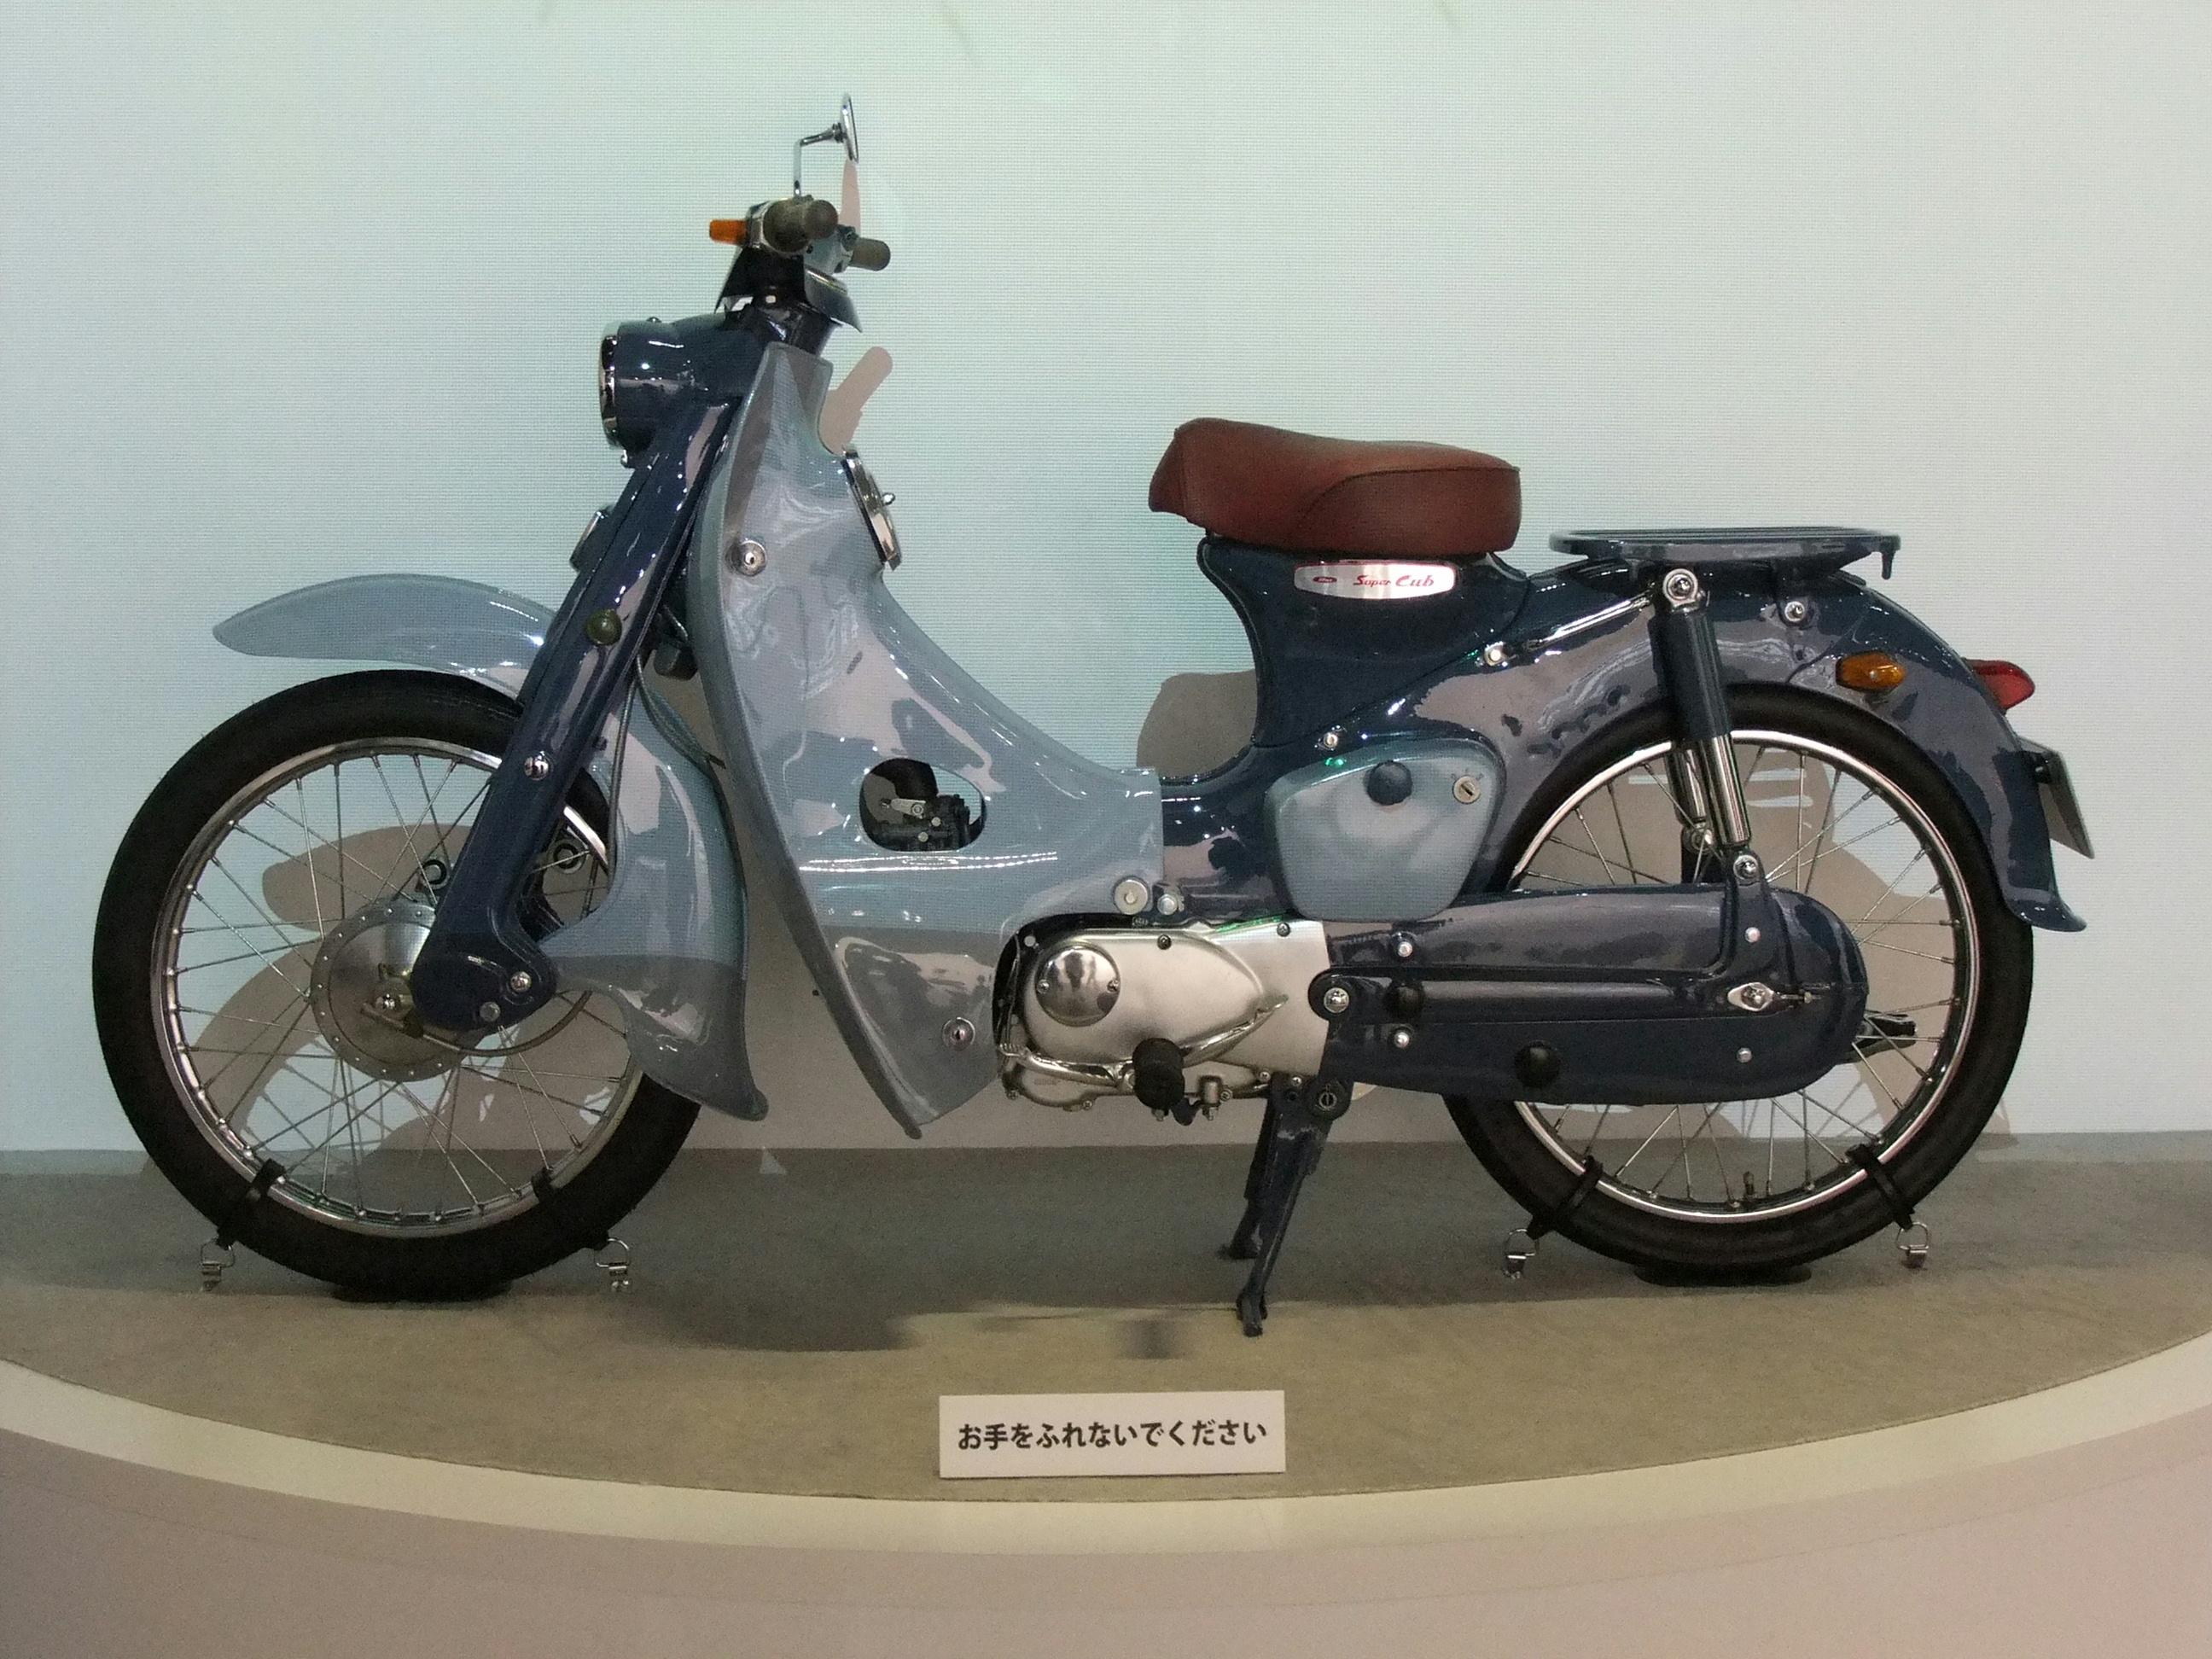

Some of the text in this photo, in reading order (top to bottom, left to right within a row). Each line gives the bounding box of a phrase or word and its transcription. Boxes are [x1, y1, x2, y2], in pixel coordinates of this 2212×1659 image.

[1395, 574, 1435, 587] Cub
[958, 1418, 1267, 1451] お手をふれないでください
